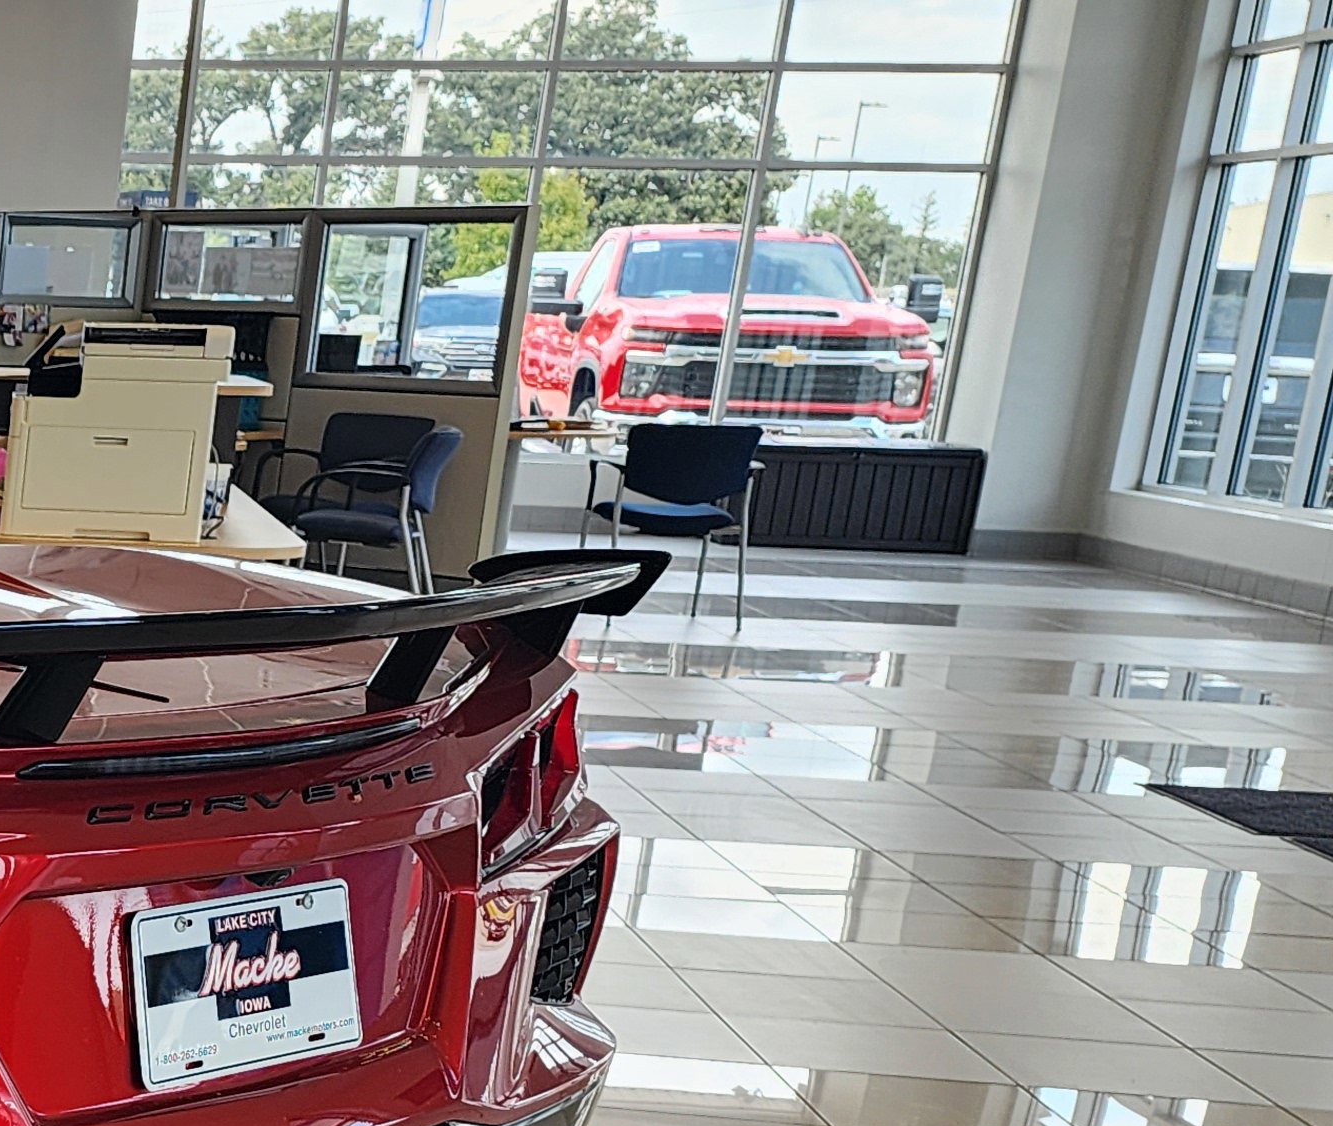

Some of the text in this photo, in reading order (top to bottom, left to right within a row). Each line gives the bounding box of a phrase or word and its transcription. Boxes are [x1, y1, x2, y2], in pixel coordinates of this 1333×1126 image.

[86, 762, 436, 826] CORVETTE
[215, 909, 277, 934] LAKE CITY
[197, 931, 302, 998] Macke
[239, 995, 272, 1015] IOWA
[229, 1015, 287, 1038] Chevrolet
[266, 1017, 355, 1043] www.mackemotors.com
